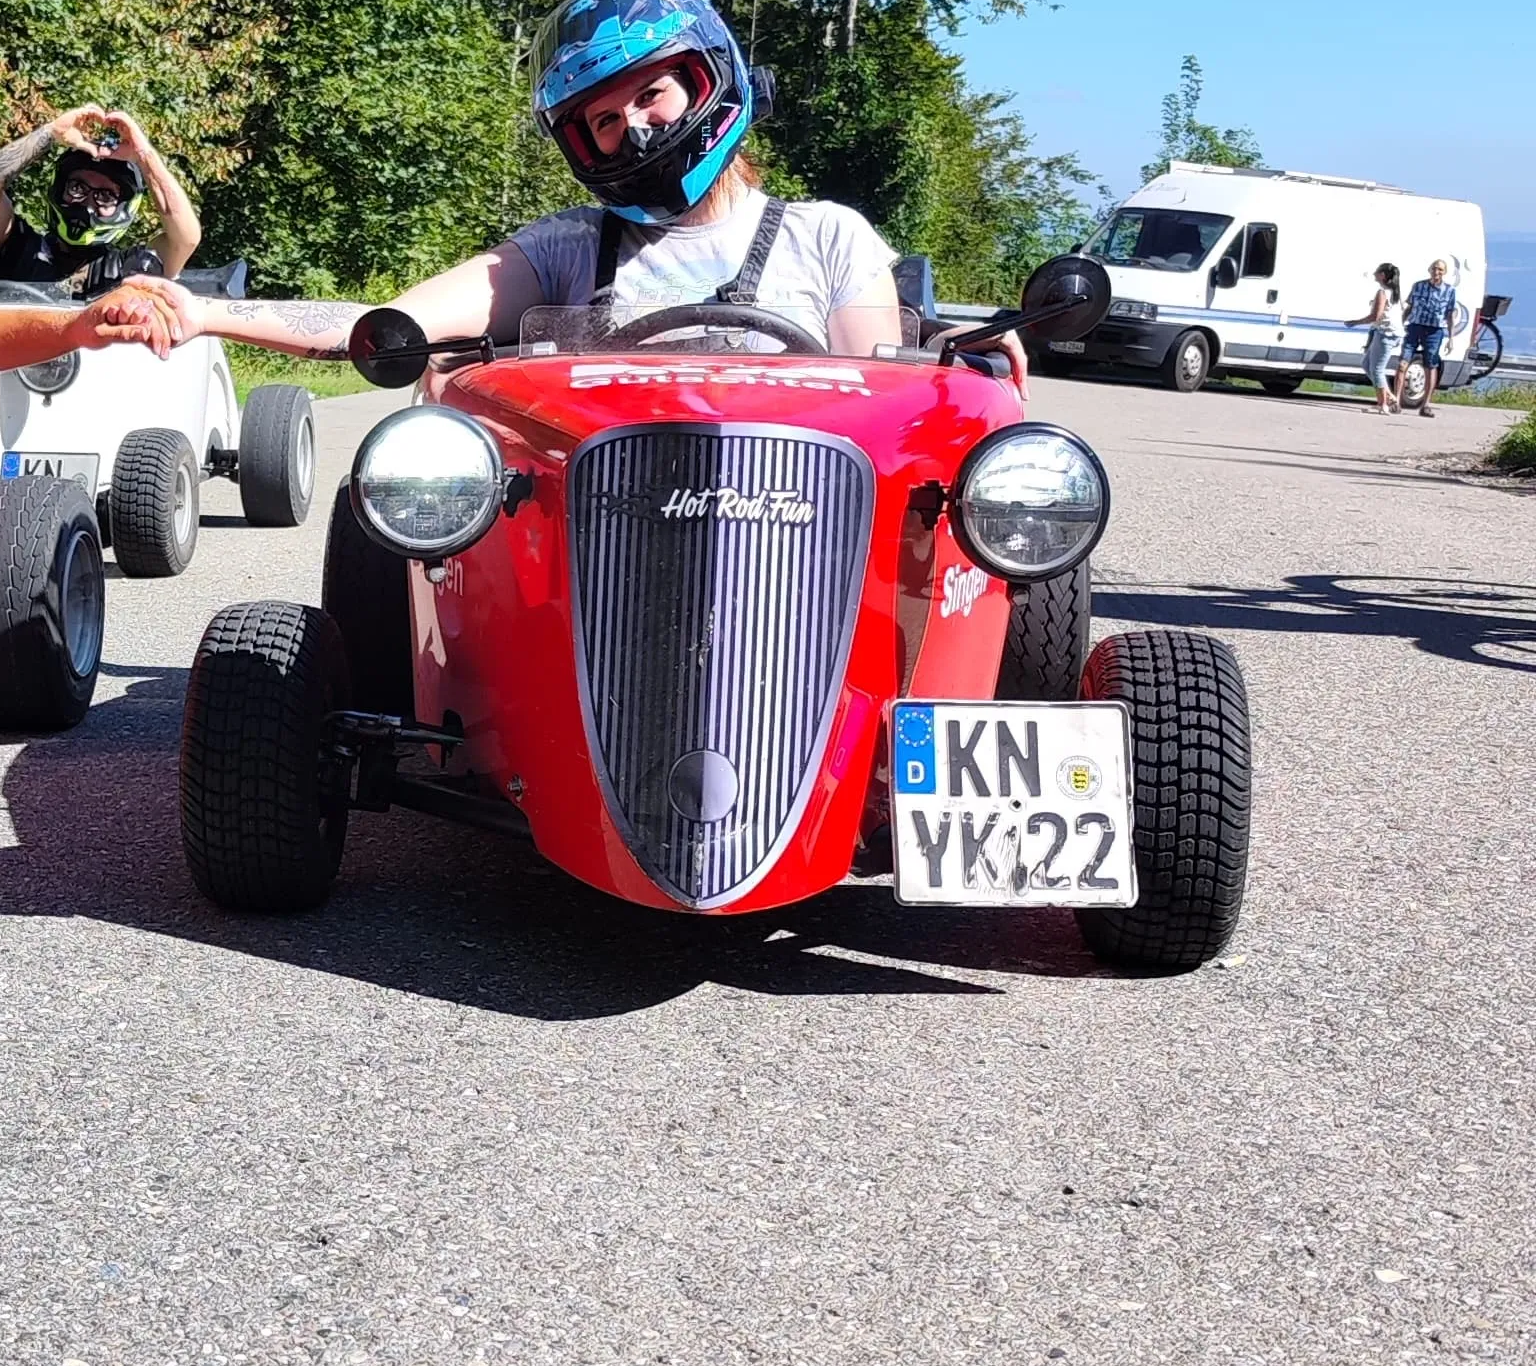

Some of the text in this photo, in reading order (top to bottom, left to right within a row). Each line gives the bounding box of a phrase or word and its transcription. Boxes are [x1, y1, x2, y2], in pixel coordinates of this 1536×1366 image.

[660, 486, 815, 523] Hot Rod Fun
[906, 760, 925, 784] D
[946, 719, 1041, 798] KN
[1026, 811, 1119, 890] 22
